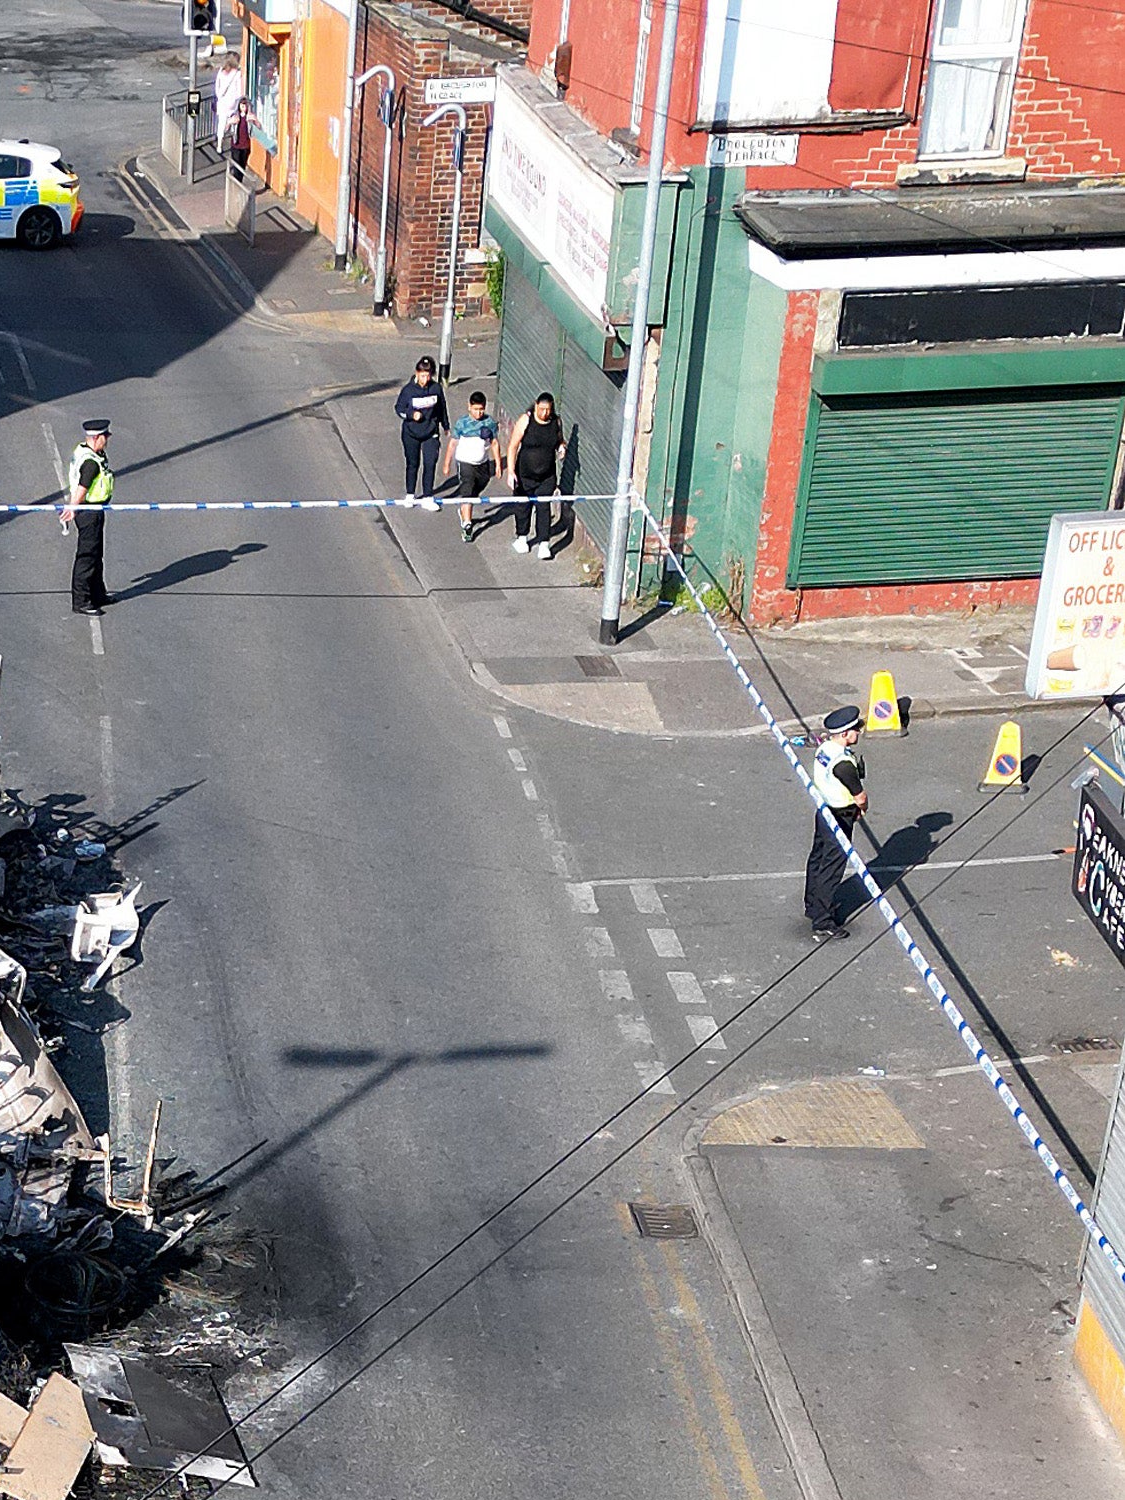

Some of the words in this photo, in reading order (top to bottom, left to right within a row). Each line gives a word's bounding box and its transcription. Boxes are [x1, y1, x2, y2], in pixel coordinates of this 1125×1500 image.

[1069, 531, 1099, 553] OFF
[1103, 556, 1115, 577] &
[1064, 583, 1125, 607] GROCER
